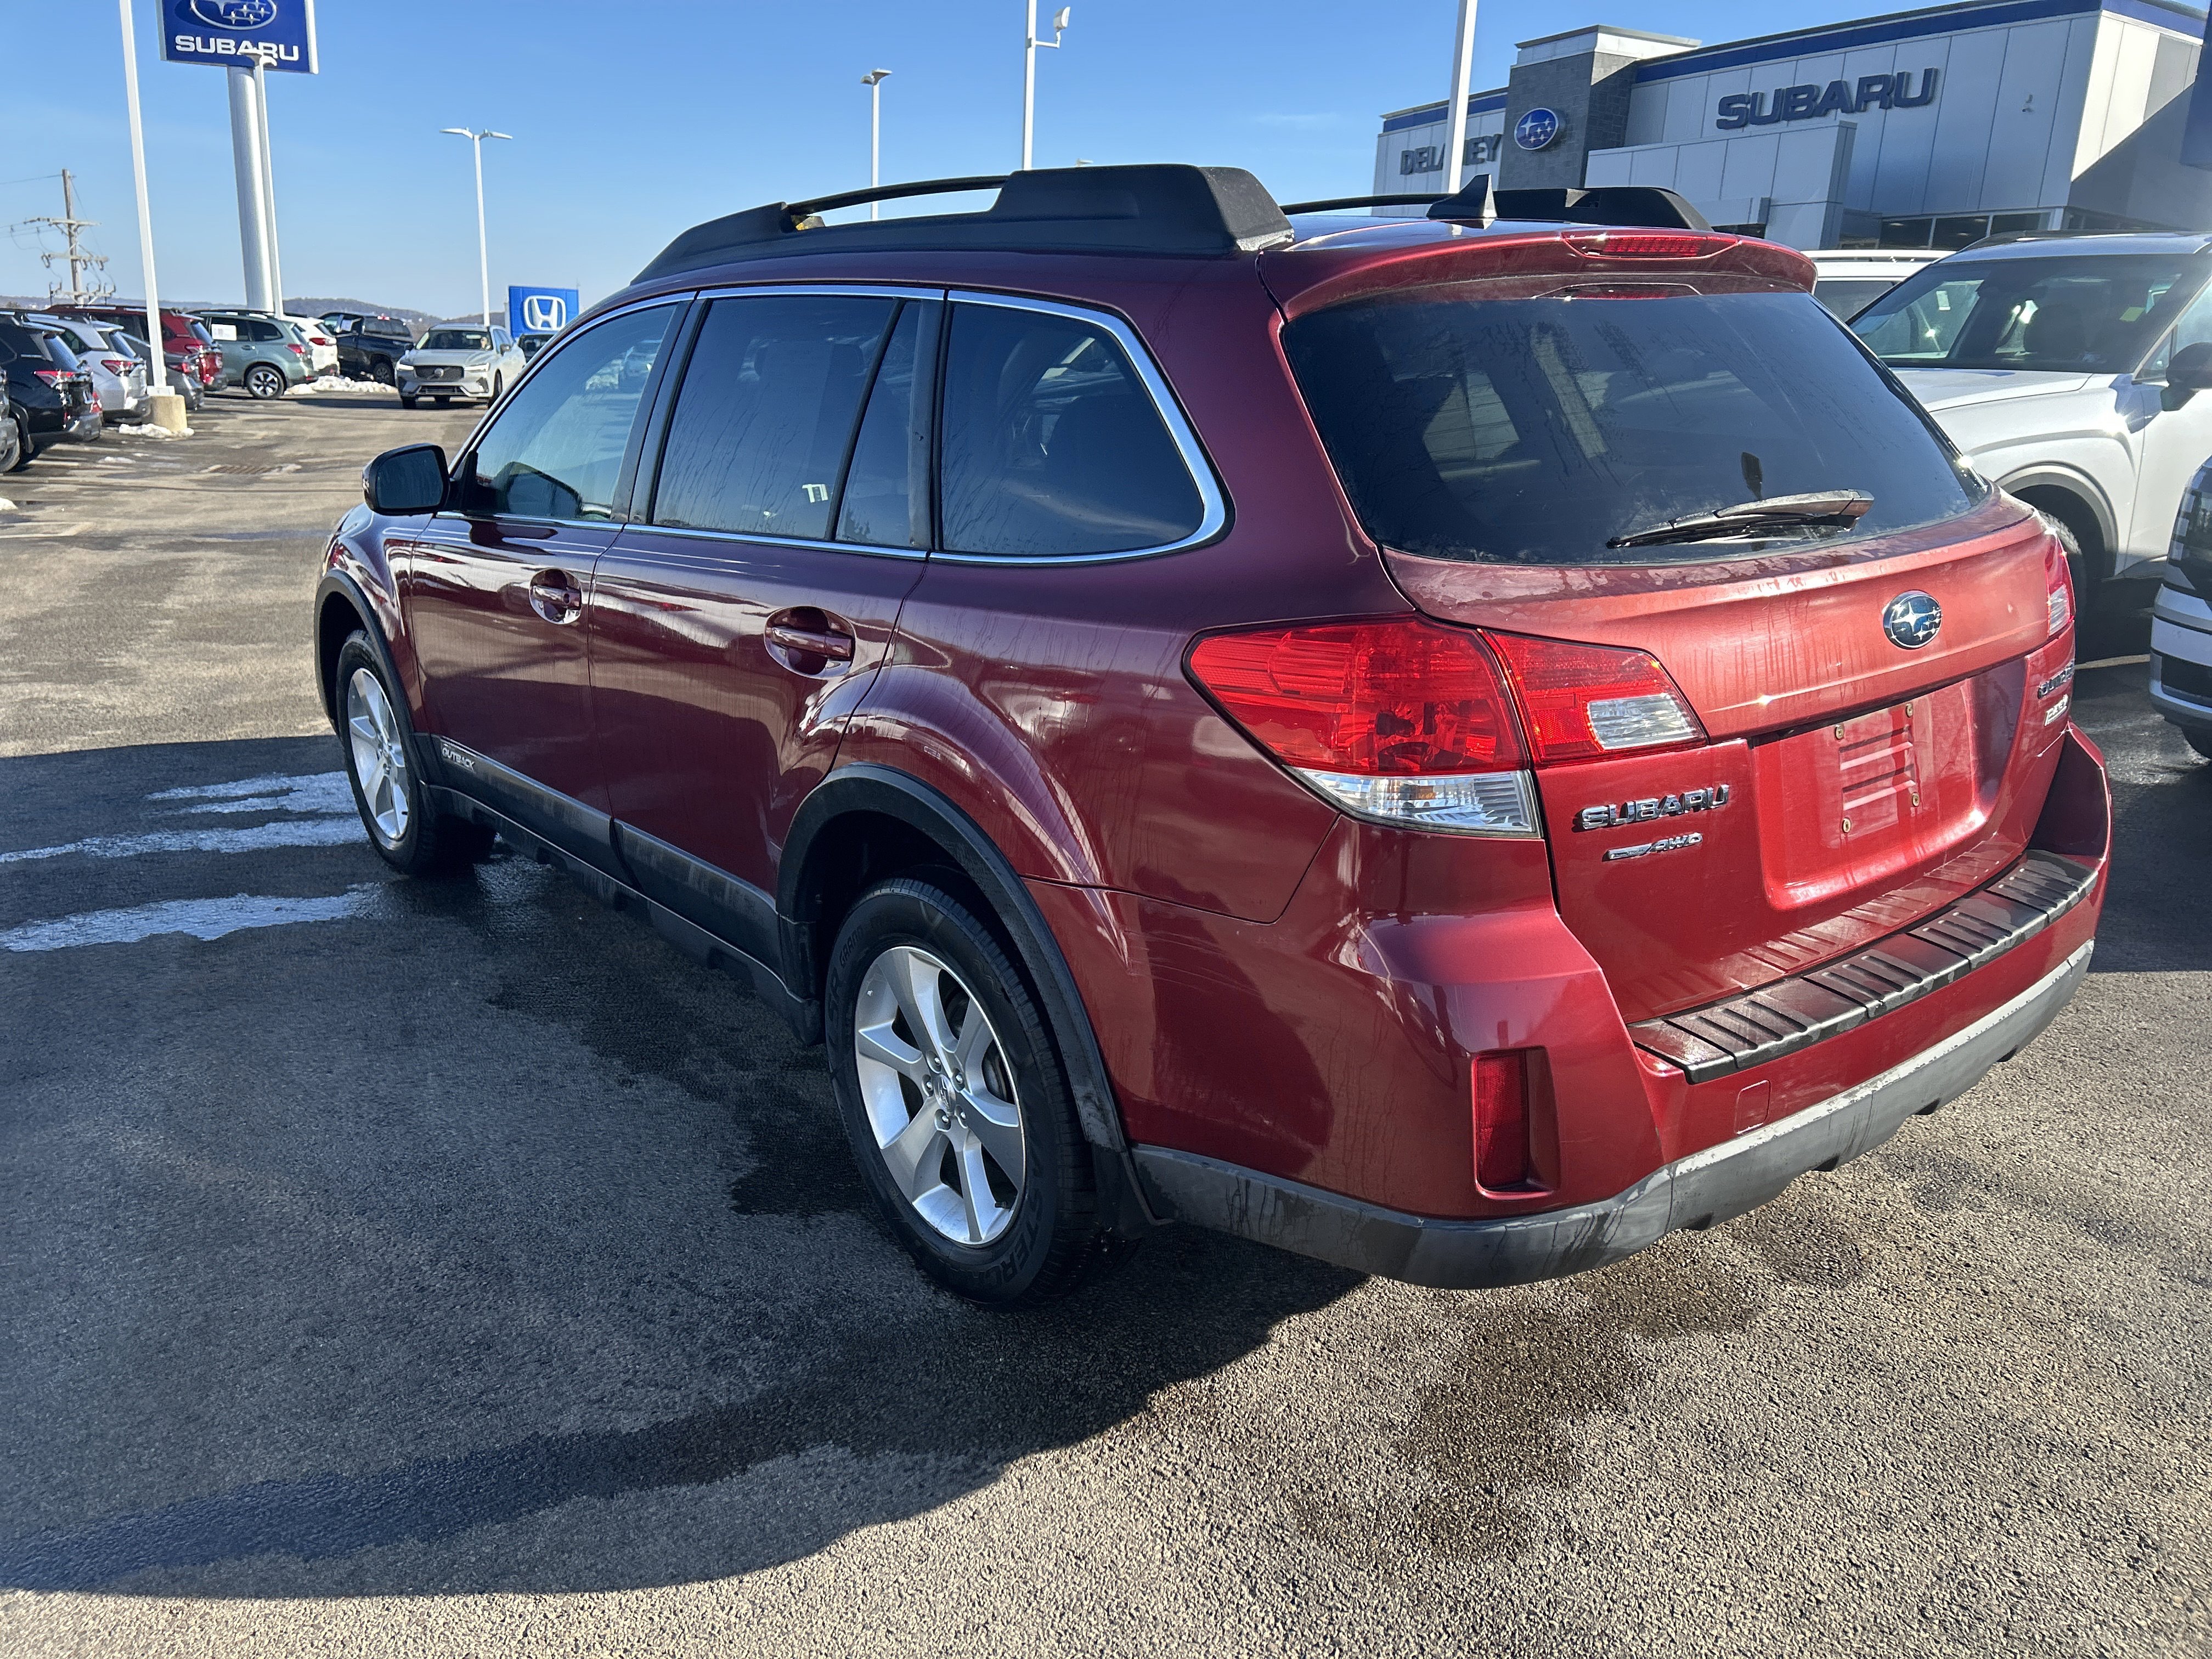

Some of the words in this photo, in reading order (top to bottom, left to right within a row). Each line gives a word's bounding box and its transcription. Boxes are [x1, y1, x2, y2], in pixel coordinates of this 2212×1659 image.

[175, 35, 299, 61] SUBARU
[1716, 67, 1938, 130] SUBARU
[1400, 133, 1503, 175] DELEY
[442, 747, 476, 771] OUTBACK
[1581, 785, 1729, 830] SUBARU
